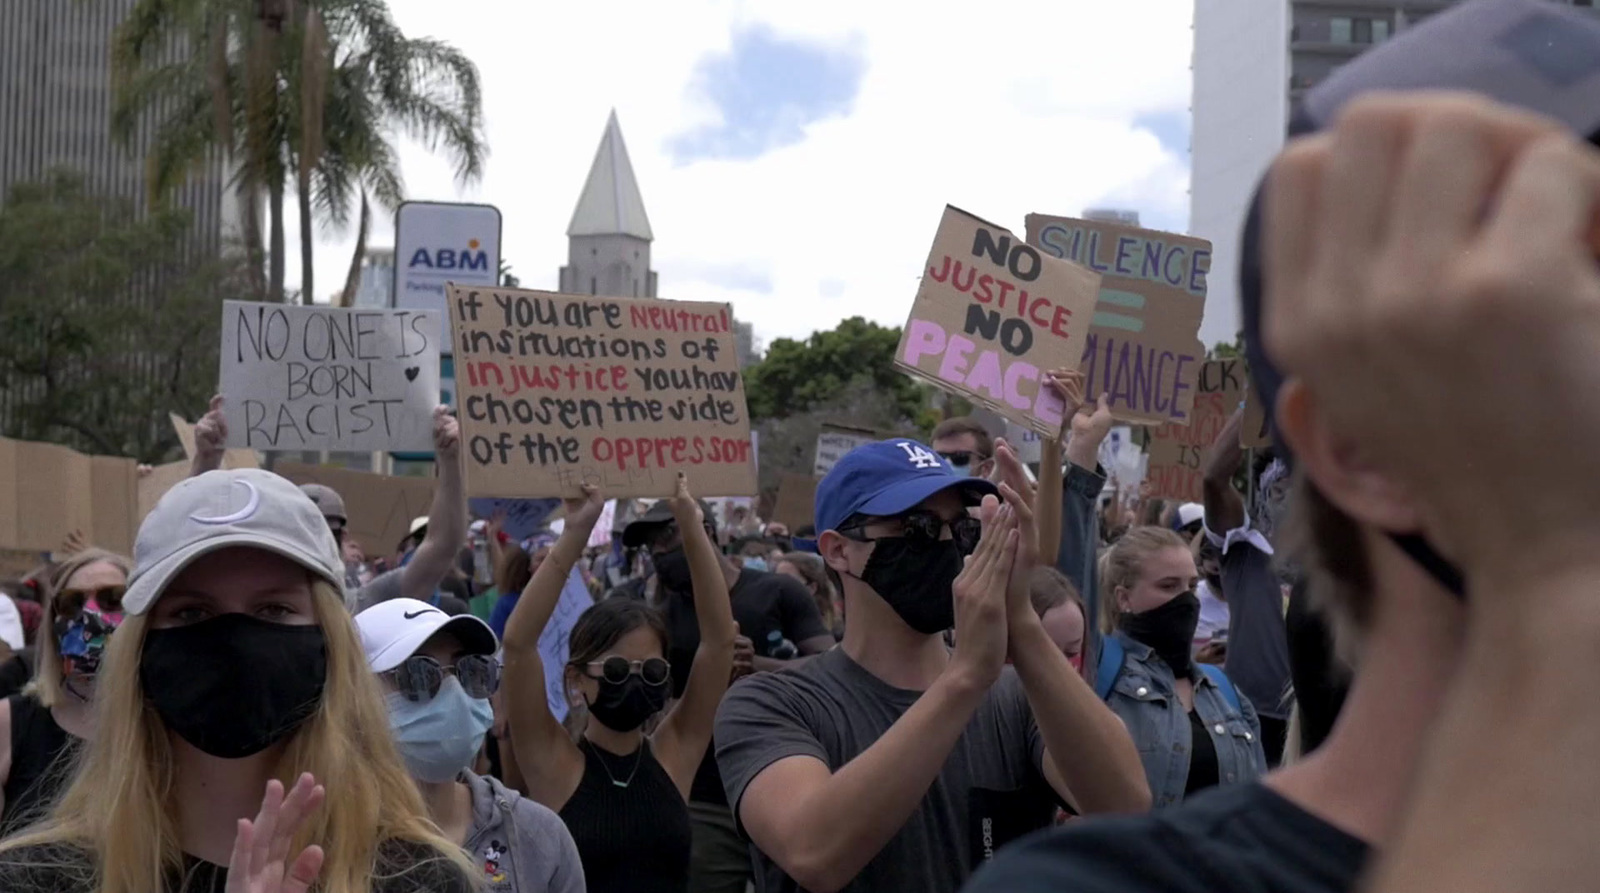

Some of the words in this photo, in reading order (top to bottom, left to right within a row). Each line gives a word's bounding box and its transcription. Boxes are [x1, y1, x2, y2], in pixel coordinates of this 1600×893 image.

[408, 247, 488, 271] ABM
[971, 227, 1042, 282] NO
[1040, 225, 1211, 294] SILENCE
[564, 302, 622, 329] are
[629, 304, 729, 333] Neutral
[929, 256, 1073, 339] JUSTICE
[237, 306, 290, 363] NO
[303, 311, 384, 361] ONE
[393, 310, 427, 358] IS
[681, 337, 720, 362] of
[964, 303, 1033, 356] NO
[287, 361, 373, 400] BORN
[464, 356, 629, 397] injustice
[1081, 333, 1195, 418] LIANCE
[1198, 360, 1239, 392] CK
[243, 399, 403, 447] RACIST
[466, 393, 604, 430] chosen
[607, 396, 663, 422] the
[668, 393, 740, 425] side
[519, 432, 580, 465] the
[591, 434, 752, 471] oppressor
[897, 442, 941, 468] LA
